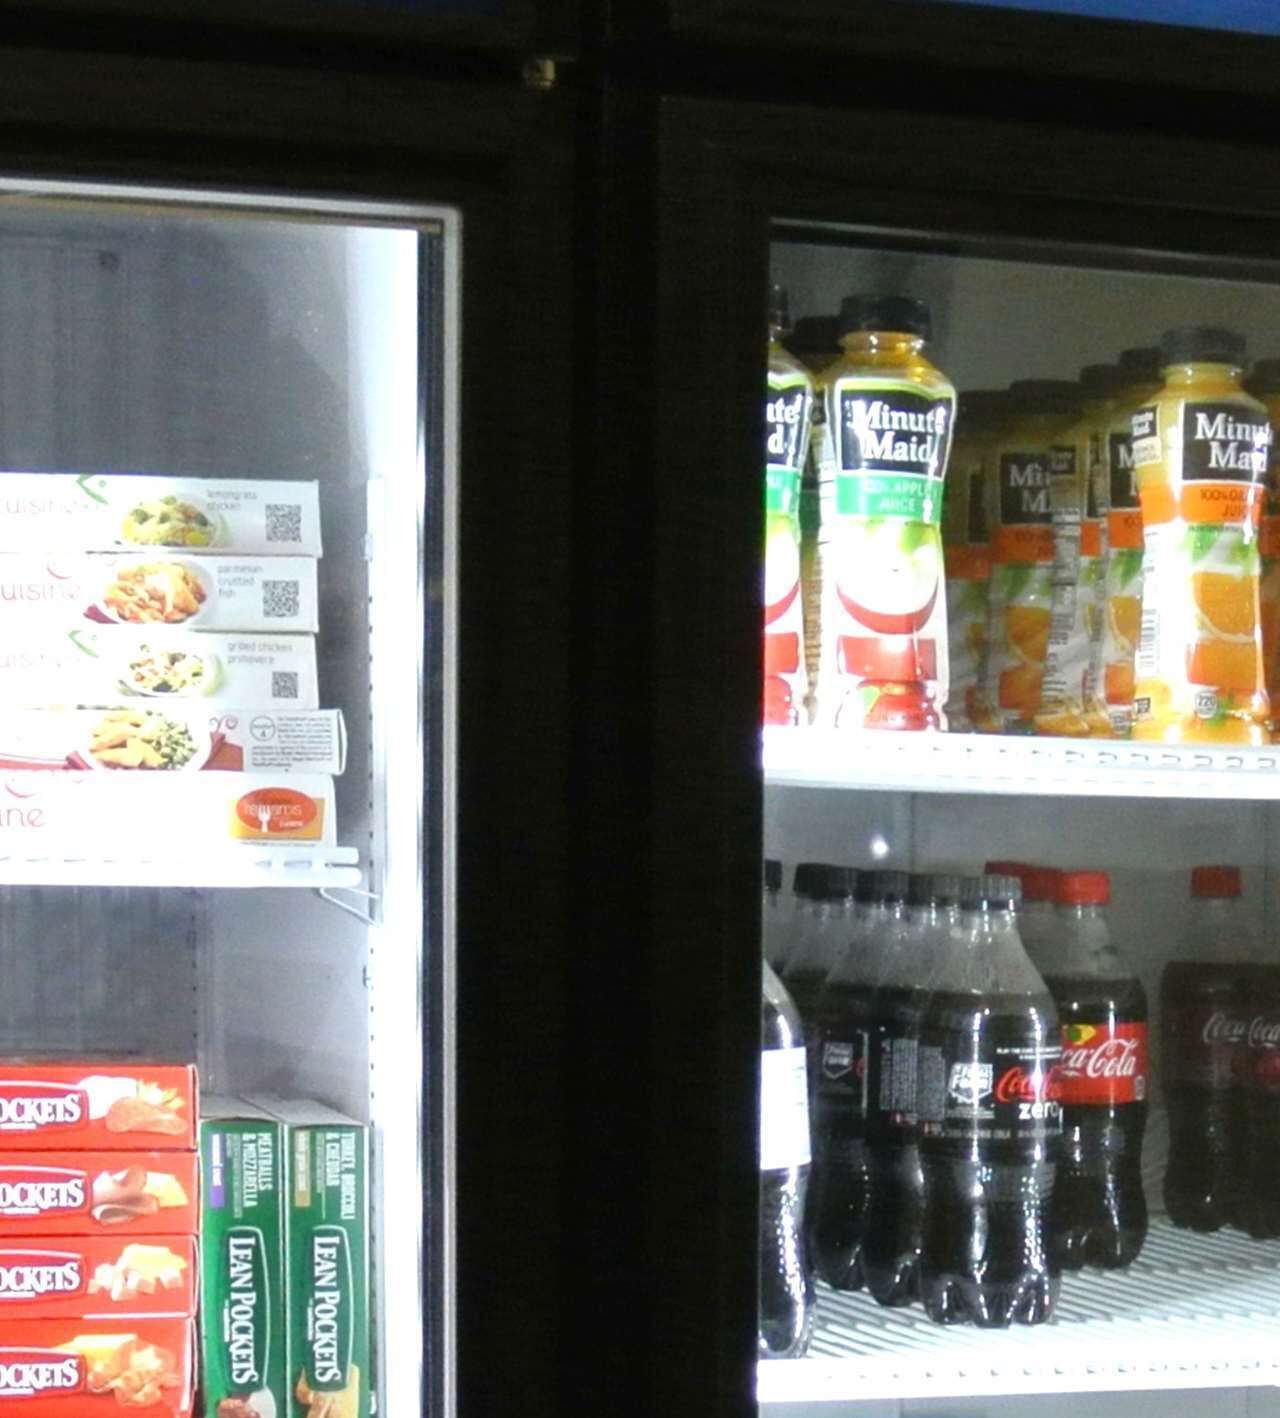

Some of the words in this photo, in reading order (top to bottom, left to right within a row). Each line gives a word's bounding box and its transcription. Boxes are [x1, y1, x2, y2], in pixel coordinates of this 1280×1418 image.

[863, 430, 933, 464] Maid
[1062, 1039, 1138, 1078] ca-Cola
[1018, 1103, 1059, 1120] zero
[229, 1236, 256, 1288] LEAN
[313, 1236, 340, 1288] LEAN
[229, 1289, 258, 1385] POCKETS
[313, 1289, 342, 1384] POCKETS
